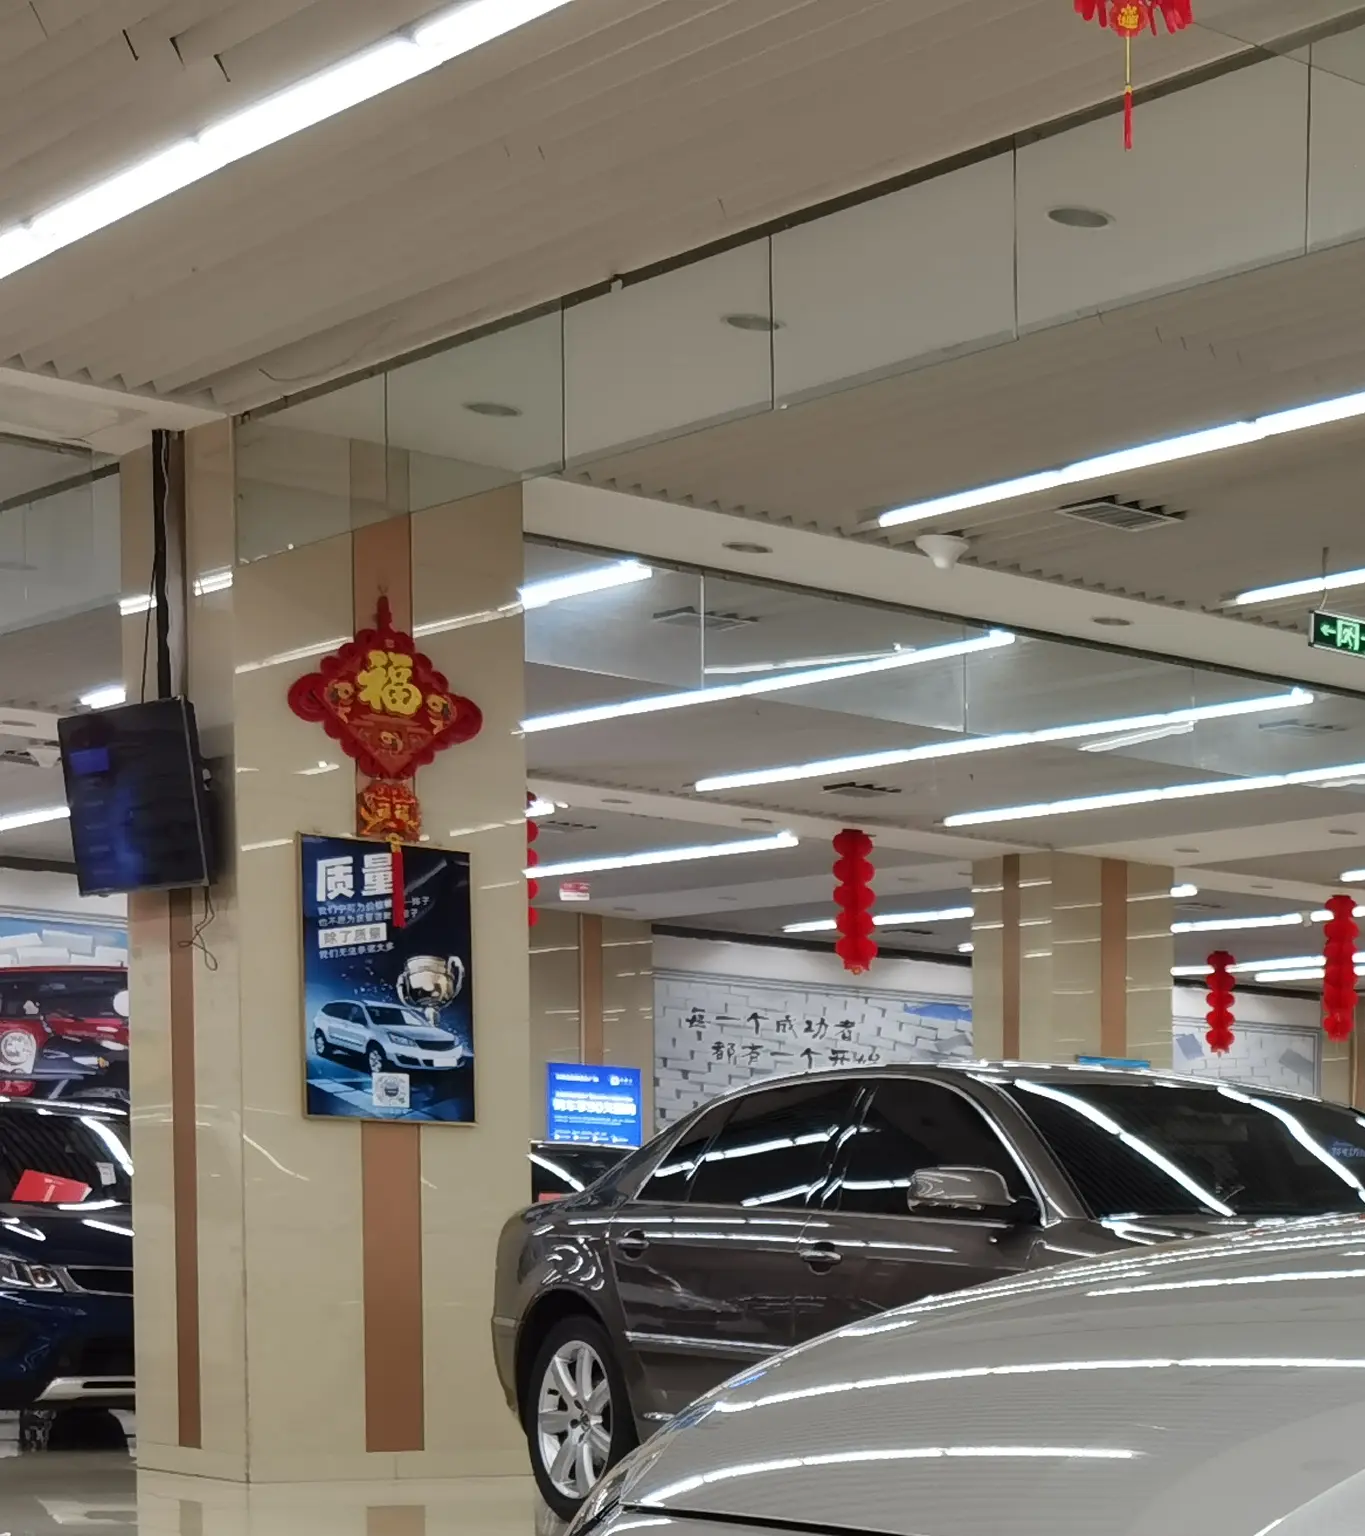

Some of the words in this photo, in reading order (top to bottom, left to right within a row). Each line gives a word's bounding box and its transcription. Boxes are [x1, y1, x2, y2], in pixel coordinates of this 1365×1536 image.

[357, 649, 423, 719] 福
[316, 852, 394, 902] 质量
[685, 1006, 856, 1041] 每一个成功者
